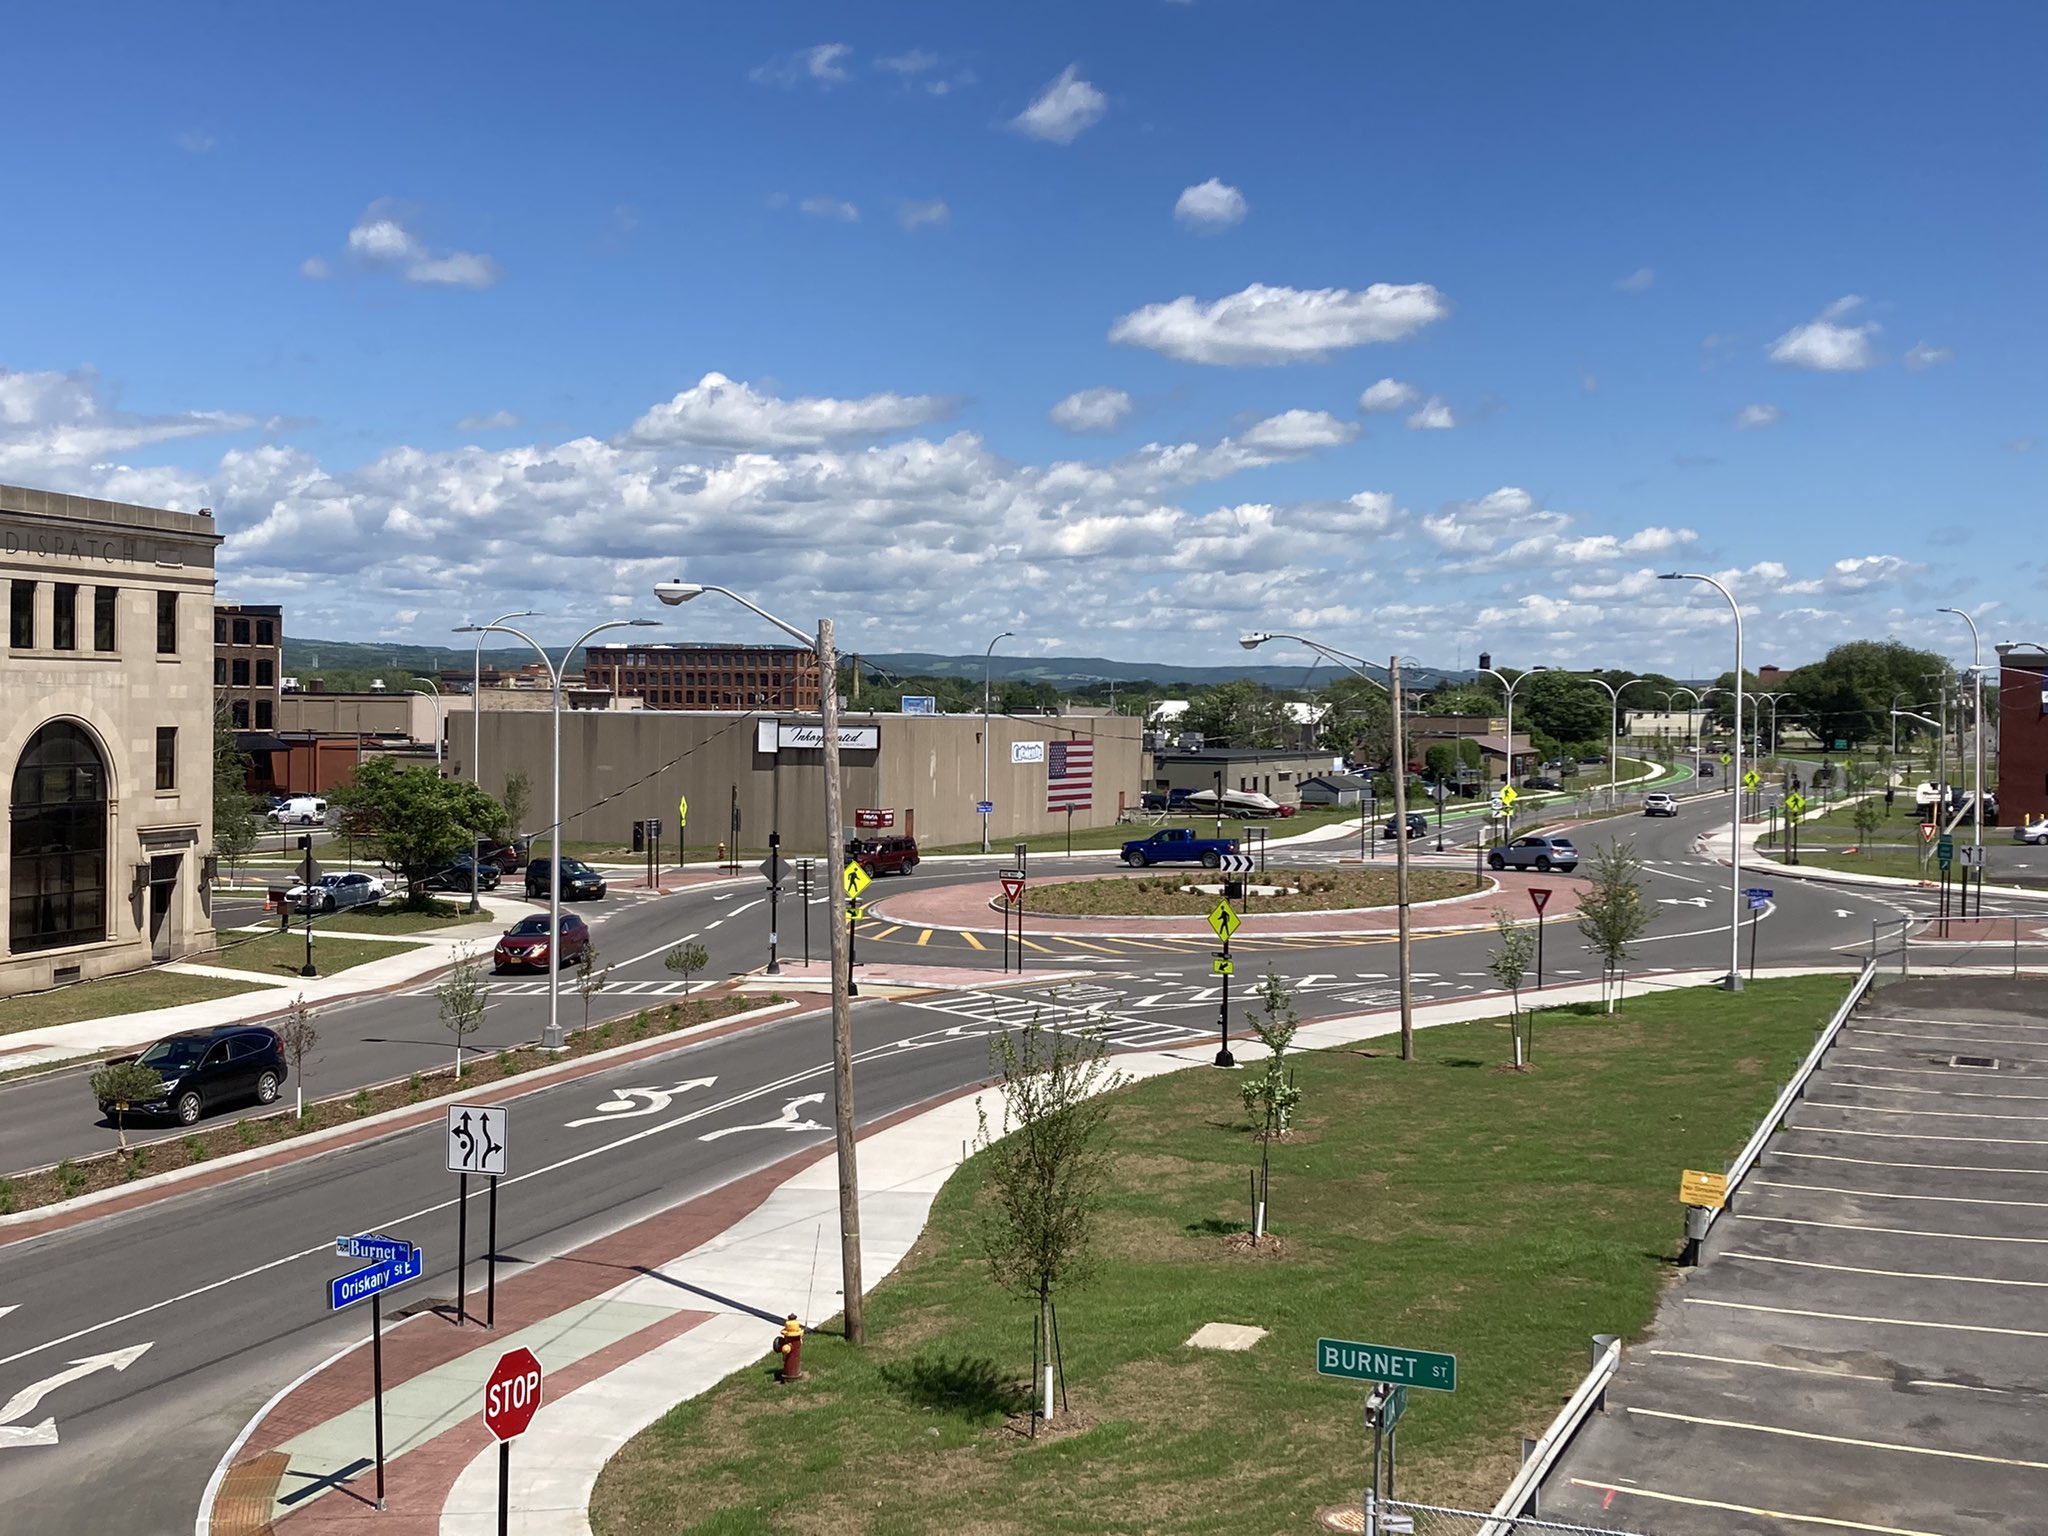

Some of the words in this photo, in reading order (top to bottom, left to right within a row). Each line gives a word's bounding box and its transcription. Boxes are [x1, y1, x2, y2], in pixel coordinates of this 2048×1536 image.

[6, 532, 134, 565] DISPATCH
[791, 726, 864, 746] Inkorpated
[350, 1239, 397, 1260] Burnet
[341, 1269, 390, 1300] Oriskany
[394, 1263, 403, 1276] St
[1325, 1347, 1418, 1378] BURNET
[1432, 1365, 1448, 1378] ST
[488, 1371, 539, 1418] STOP
